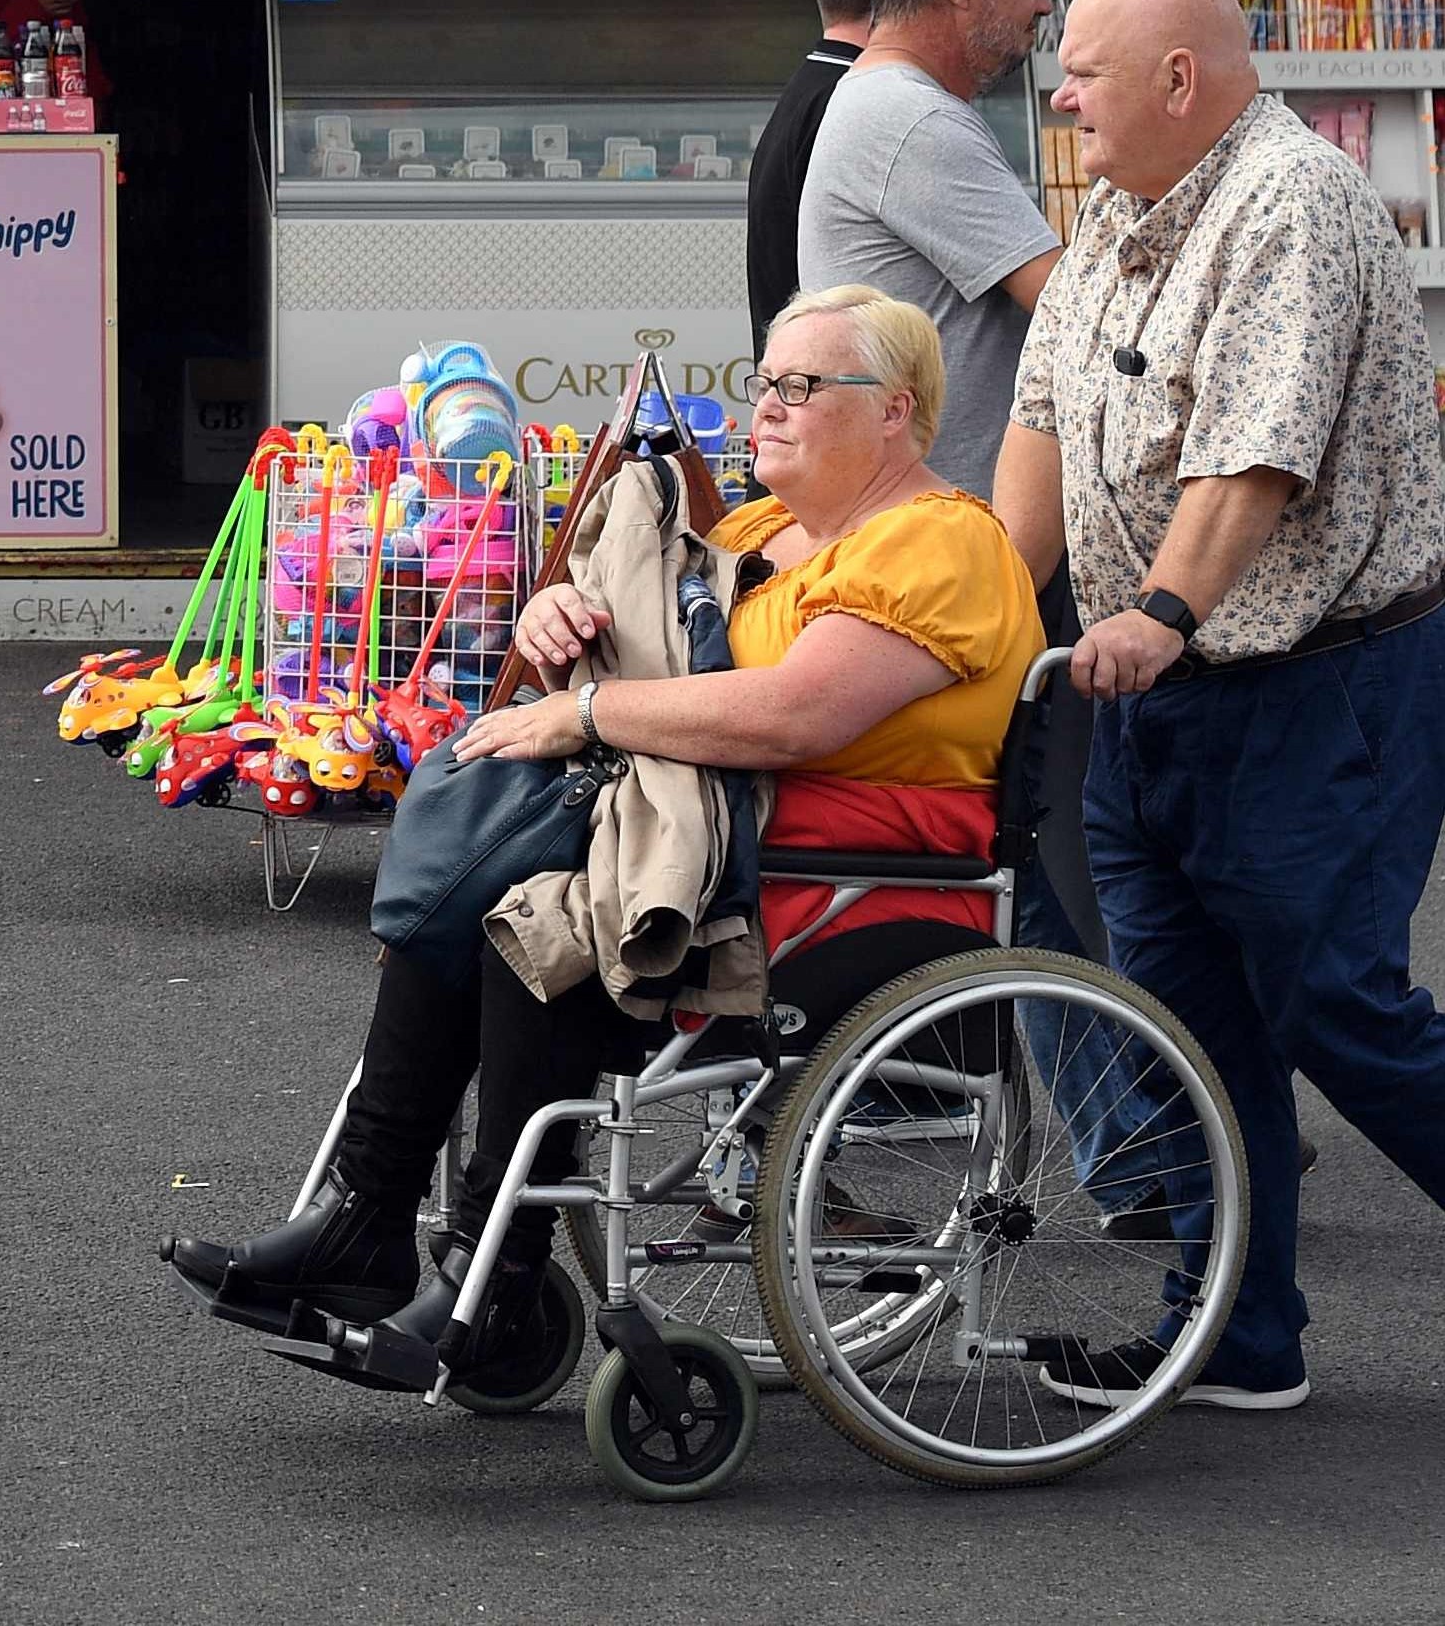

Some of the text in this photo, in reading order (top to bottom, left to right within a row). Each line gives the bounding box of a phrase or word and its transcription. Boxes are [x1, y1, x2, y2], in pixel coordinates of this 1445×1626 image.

[1274, 61, 1311, 78] 99P
[1318, 61, 1375, 78] EACH
[1383, 60, 1414, 78] OR
[9, 433, 86, 472] SOLD
[10, 478, 86, 519] HERE
[12, 598, 126, 625] CREAM
